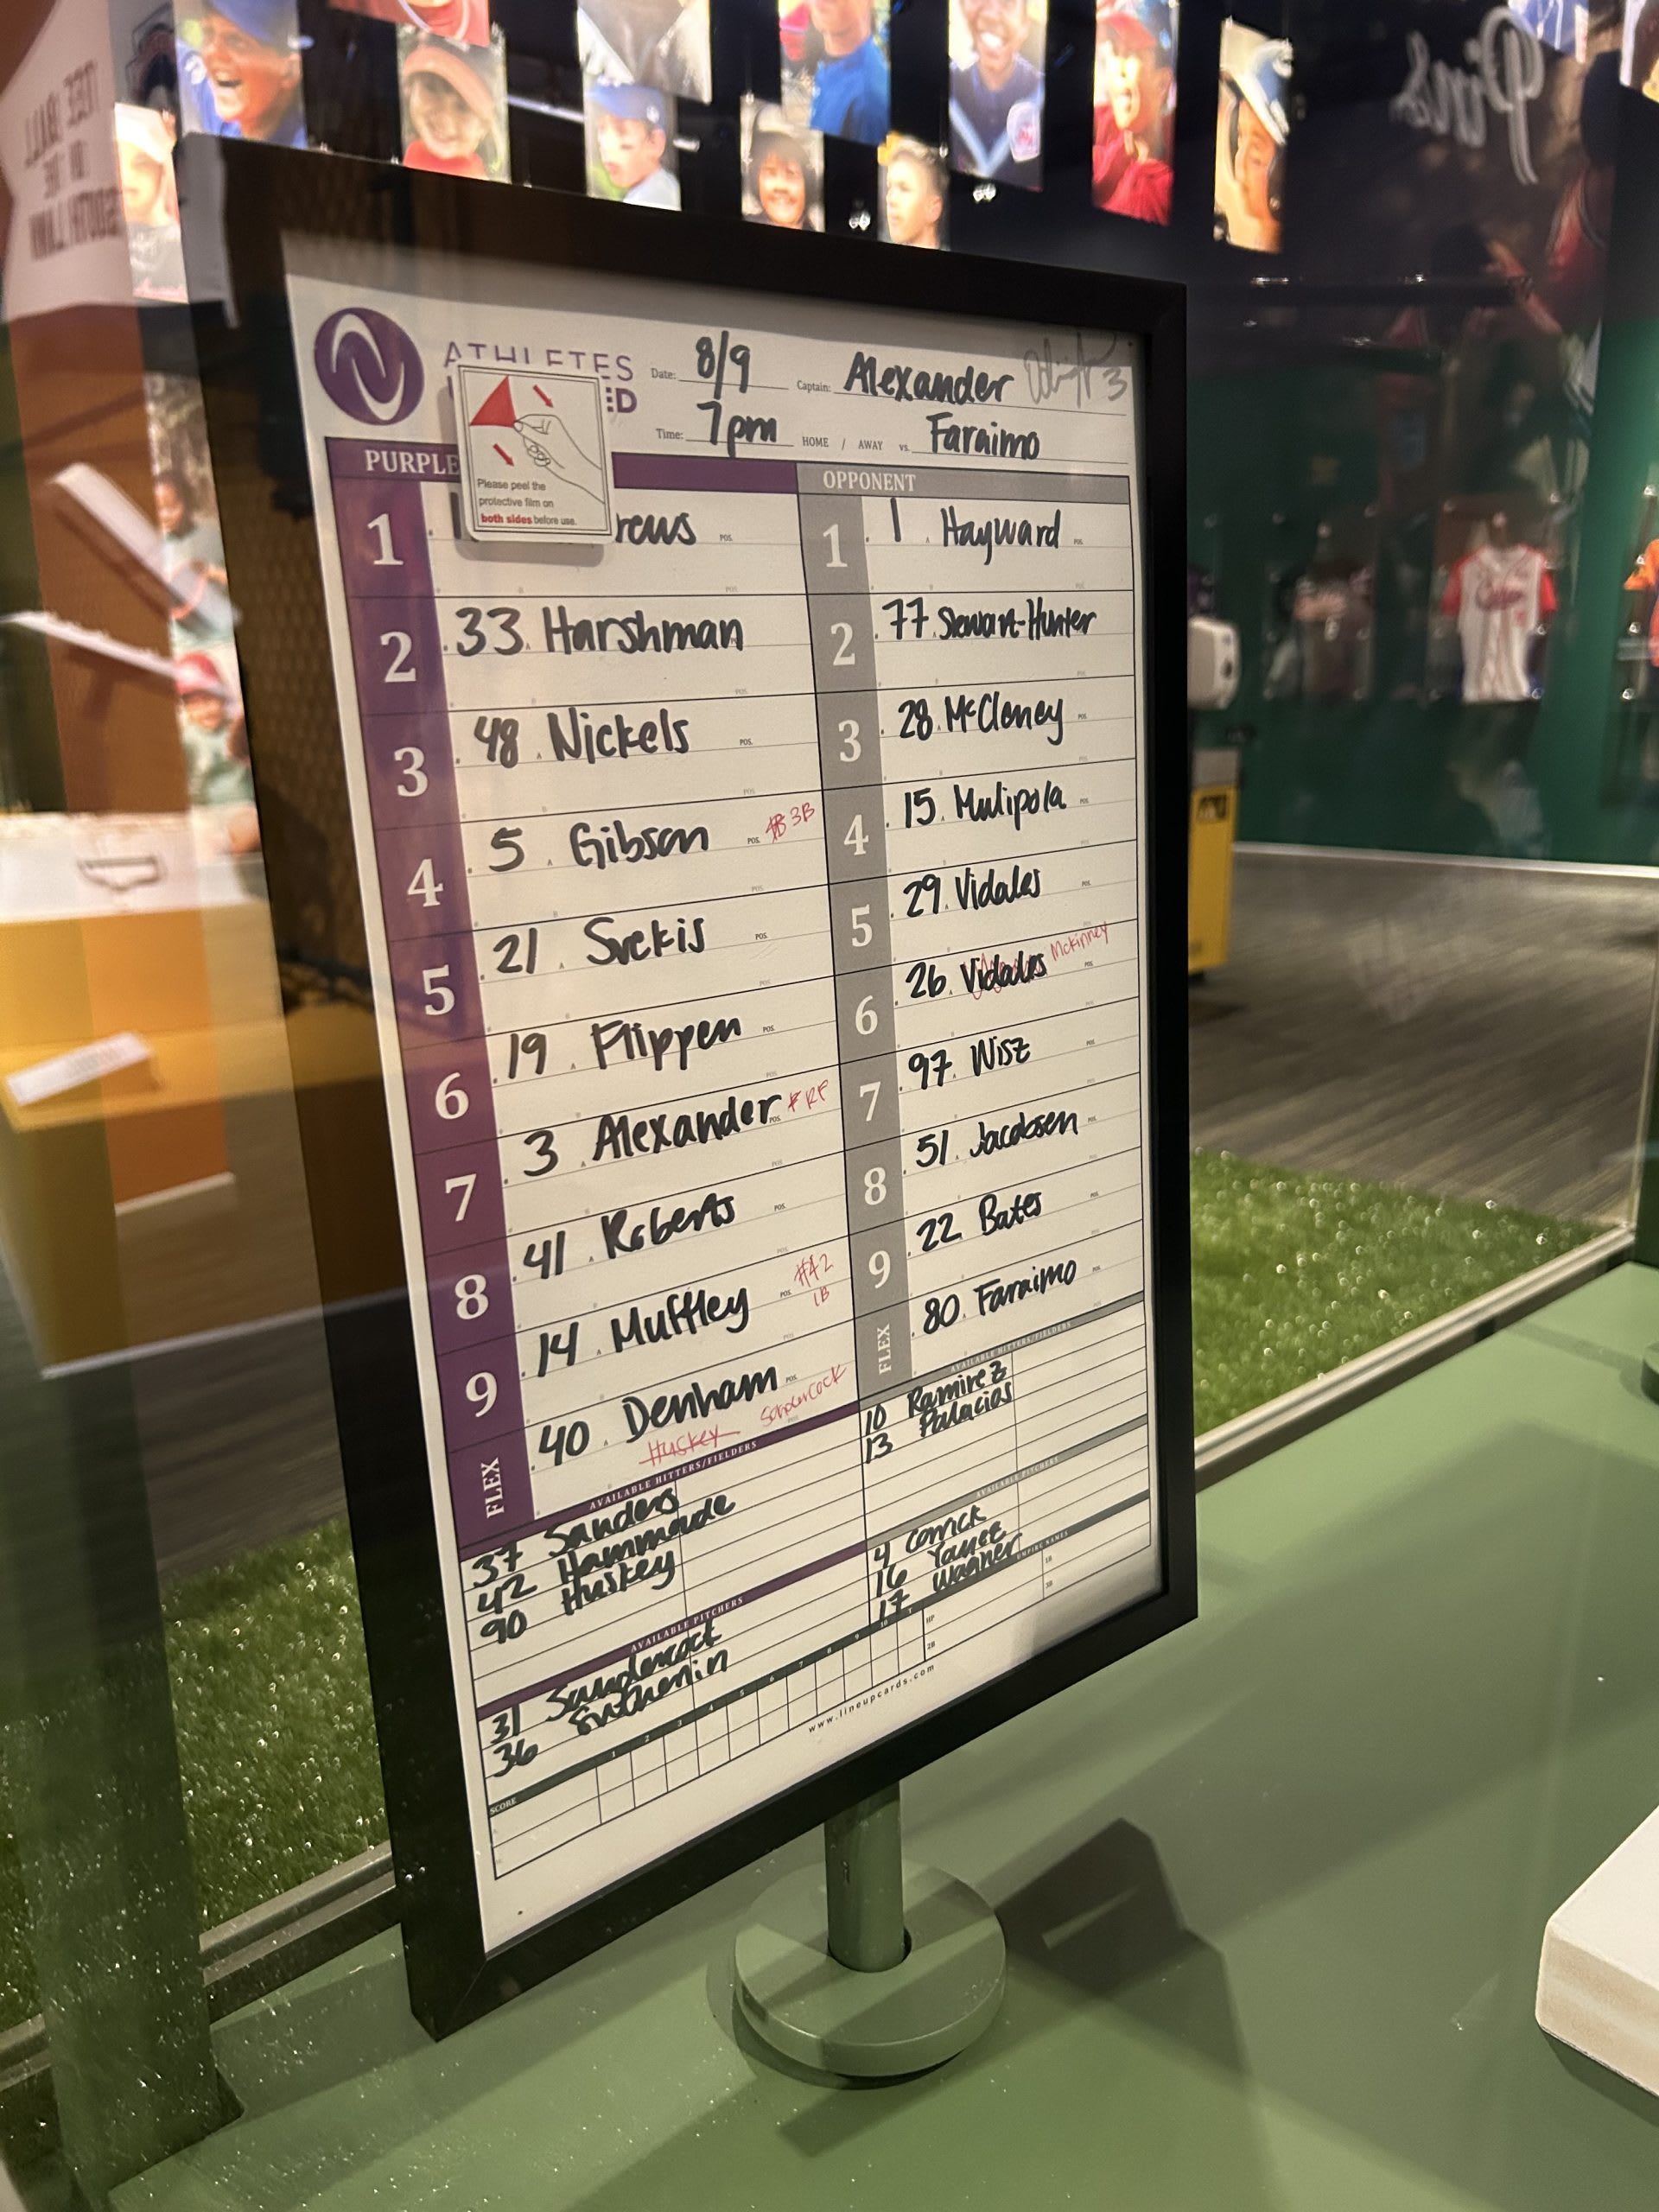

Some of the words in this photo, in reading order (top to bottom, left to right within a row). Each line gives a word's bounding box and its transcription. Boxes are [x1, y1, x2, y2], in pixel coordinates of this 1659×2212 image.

[651, 367, 677, 380] Date:
[696, 330, 750, 400] 8/9
[797, 380, 831, 393] Captain:
[843, 351, 1014, 404] Alexander
[656, 428, 683, 440] Time:
[802, 435, 830, 448] HOME
[858, 439, 883, 450] AWAY
[925, 411, 1039, 460] Faraimo
[365, 449, 460, 476] PURPLE
[823, 470, 916, 492] OPPONENT
[477, 478, 509, 490] Please
[512, 480, 530, 492] peel
[531, 480, 546, 491] the
[479, 497, 523, 508] protective
[524, 497, 541, 507] film
[367, 513, 404, 566] 1
[481, 514, 504, 524] both
[506, 515, 532, 524] sides
[534, 516, 559, 526] before
[940, 505, 1061, 565] Hayward
[823, 524, 848, 568] 1
[455, 607, 524, 657] 33
[542, 605, 743, 654] Harshman
[881, 596, 929, 639] 77
[380, 632, 416, 683] 2
[830, 623, 855, 666] 2
[474, 715, 518, 768] 48
[547, 707, 690, 764] Nickels
[838, 719, 861, 762] 3
[898, 698, 933, 741] 28
[393, 747, 429, 798] 3
[790, 802, 815, 826] 3B
[904, 787, 937, 829] 15
[488, 827, 525, 873] 5
[569, 820, 709, 869] Gibson
[843, 814, 869, 855] 4
[407, 859, 443, 907] 4
[903, 874, 941, 918] 29
[955, 864, 1040, 910] Vidales
[850, 904, 873, 947] 5
[493, 927, 537, 975] 21
[423, 965, 455, 1015] 5
[905, 961, 946, 999] 26
[855, 995, 878, 1035] 6
[508, 1033, 547, 1079] 19
[908, 1049, 953, 1090] 97
[434, 1071, 469, 1121] 6
[859, 1082, 880, 1122] 7
[523, 1129, 559, 1176] 3
[592, 1093, 782, 1160] Alexander
[916, 1129, 949, 1167] 51
[443, 1173, 476, 1222] 7
[864, 1167, 887, 1205] 8
[523, 1230, 565, 1281] 41
[600, 1192, 736, 1260] Roberts
[916, 1212, 963, 1252] 22
[978, 1192, 1042, 1236] Bates
[868, 1249, 891, 1289] 9
[454, 1274, 488, 1320] 8
[923, 1294, 960, 1334] 80
[537, 1321, 579, 1377] 14
[610, 1287, 749, 1353] Muffley
[877, 1323, 892, 1375] FLEX
[465, 1371, 498, 1417] 9
[538, 1421, 589, 1465] 40
[622, 1366, 778, 1443] Denham
[865, 1403, 887, 1436] 10
[866, 1432, 893, 1464] 13
[481, 1457, 505, 1518] FLEX
[589, 1480, 652, 1510] AVAILABLE
[655, 1440, 758, 1484] HITTERS/FIELDERS
[874, 1540, 891, 1568] 4
[1046, 1530, 1070, 1546] NAMES
[472, 1541, 524, 1588] 37
[876, 1563, 908, 1599] 16
[477, 1573, 537, 1614] 42
[879, 1587, 910, 1621] 17
[480, 1609, 528, 1644] 90
[631, 1620, 690, 1653] AVAILABLE
[693, 1597, 744, 1624] PITCHERS
[880, 1619, 888, 1628] 10
[926, 1614, 935, 1624] HP
[927, 1641, 936, 1650] 2B
[809, 1664, 934, 1733] www.lineupcards.com
[490, 1704, 520, 1745] 31
[493, 1738, 538, 1777] 36
[489, 1796, 518, 1815] SCORE
